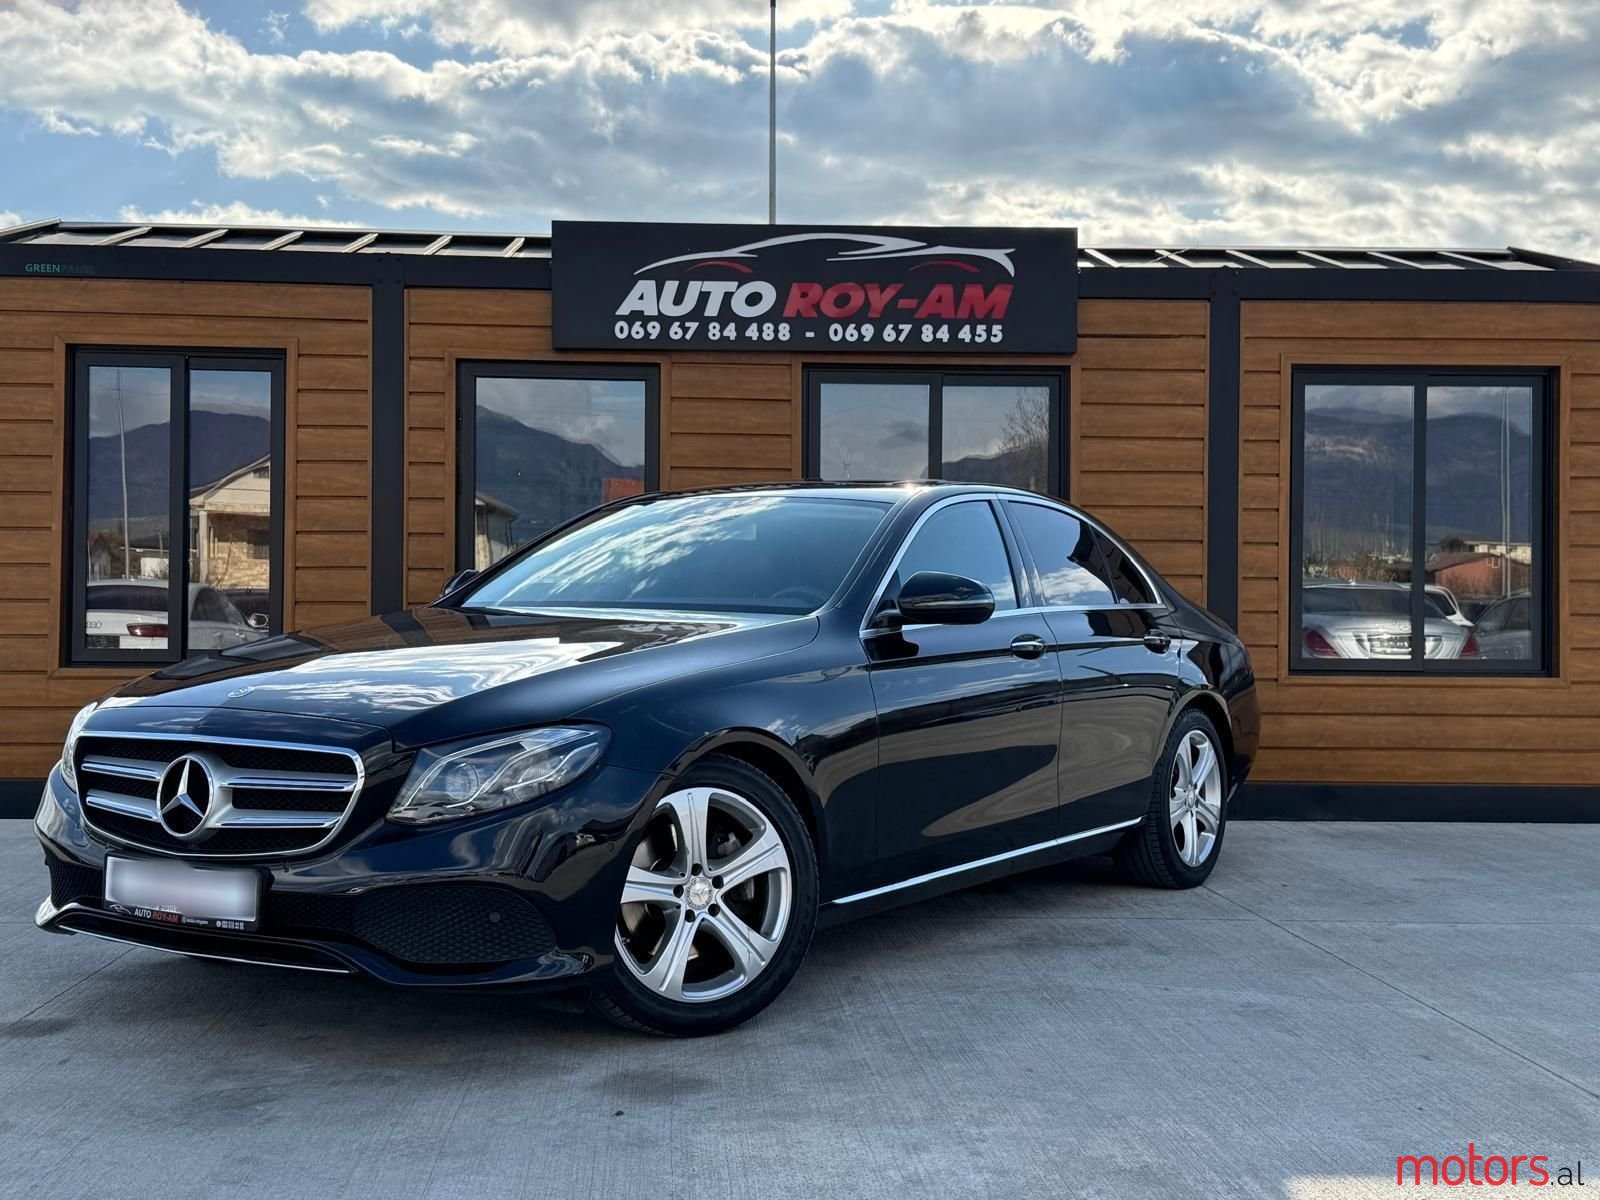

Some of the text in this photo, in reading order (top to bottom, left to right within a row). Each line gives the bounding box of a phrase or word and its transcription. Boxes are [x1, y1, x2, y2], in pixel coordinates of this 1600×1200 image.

[614, 279, 1014, 319] AUTO ROY-AM
[614, 320, 661, 340] 069
[669, 321, 700, 341] 67
[707, 321, 738, 341] 84
[744, 322, 791, 342] 488
[828, 323, 875, 342] 069
[882, 323, 913, 343] 67
[920, 324, 950, 343] 84
[957, 324, 1004, 343] 455
[134, 908, 151, 919] AUTO
[153, 911, 178, 923] ROY-AM
